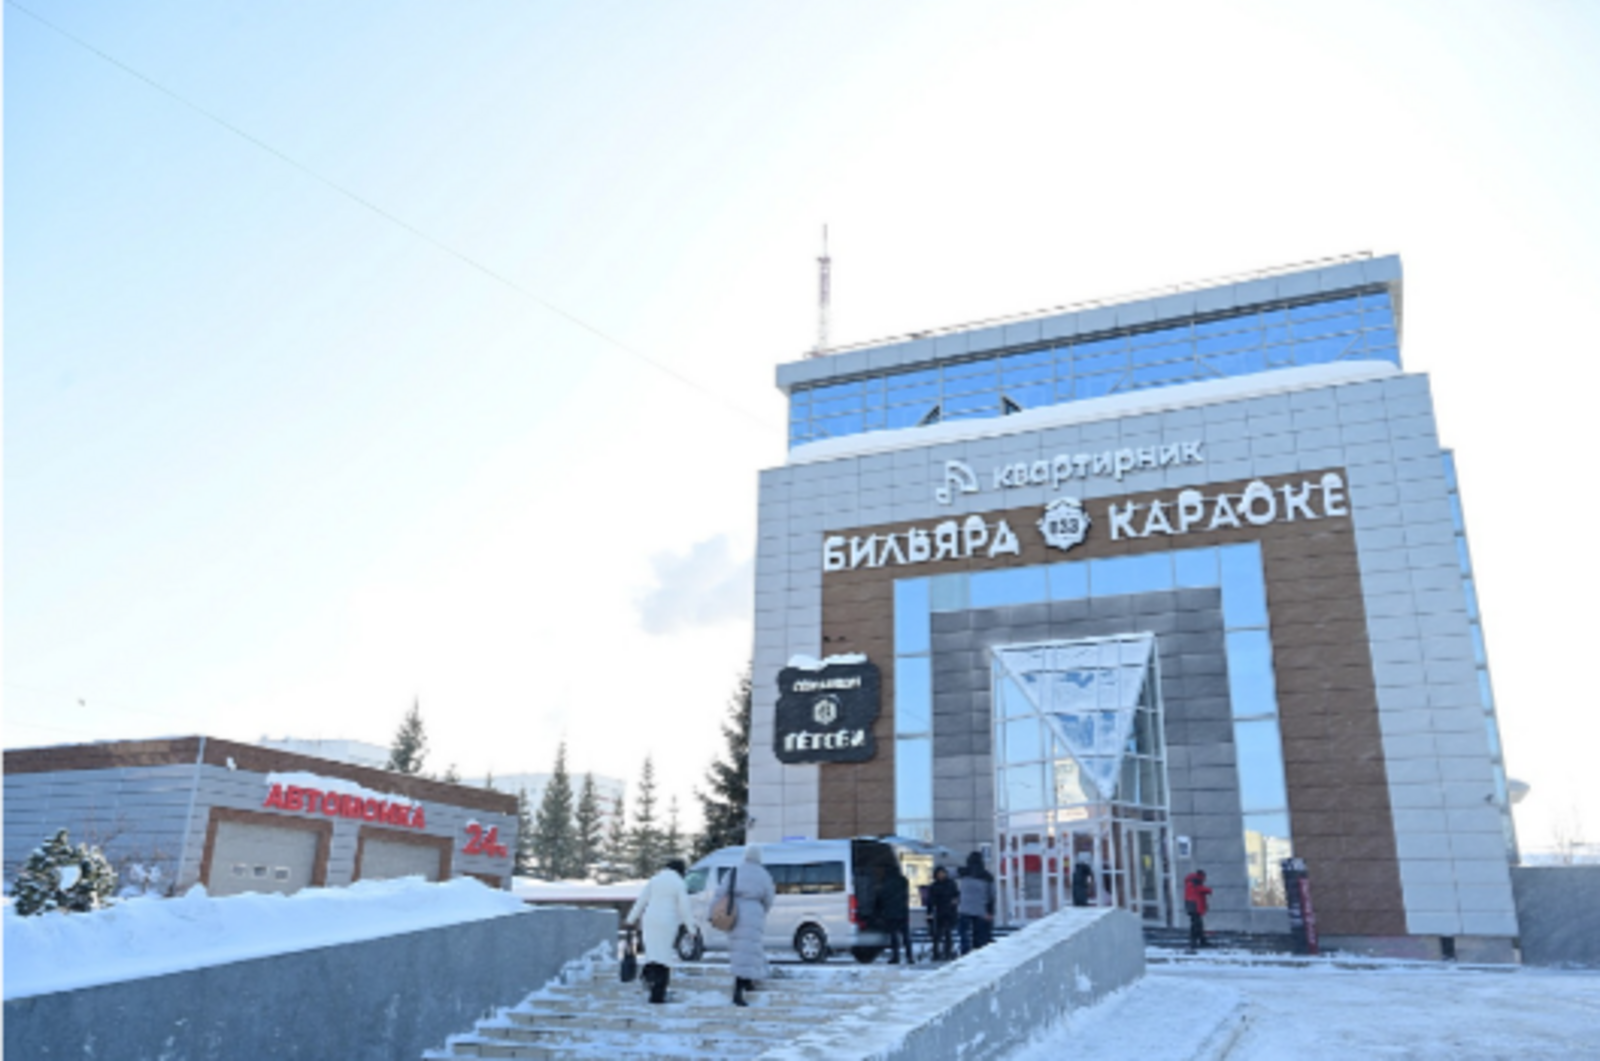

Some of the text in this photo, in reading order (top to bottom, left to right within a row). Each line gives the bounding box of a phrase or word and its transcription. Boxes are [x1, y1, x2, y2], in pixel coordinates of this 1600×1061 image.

[993, 439, 1204, 491] квартирник
[823, 474, 1348, 571] БИЛЬЯРД КАРАОКЕ
